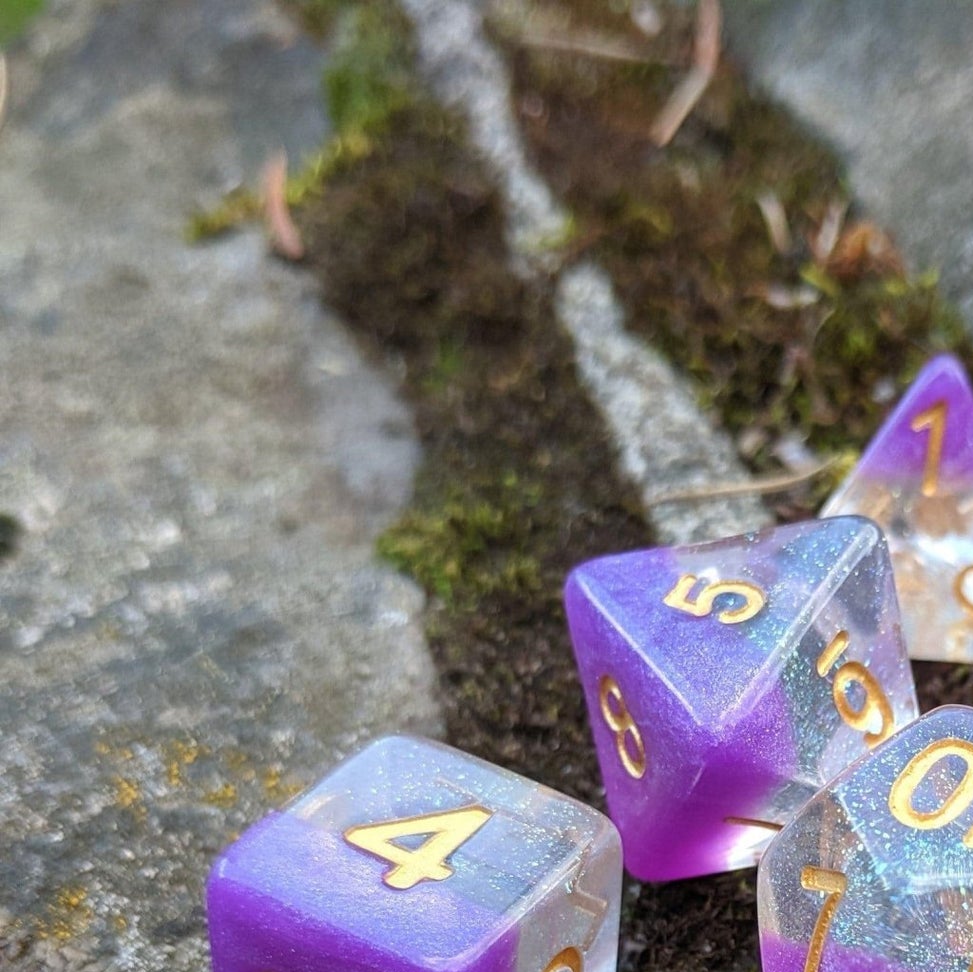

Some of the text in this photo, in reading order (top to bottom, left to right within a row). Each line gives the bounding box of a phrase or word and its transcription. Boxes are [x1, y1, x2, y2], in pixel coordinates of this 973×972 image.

[911, 400, 948, 497] 1
[662, 573, 766, 625] 5
[599, 674, 646, 779] 8
[343, 804, 494, 891] 4
